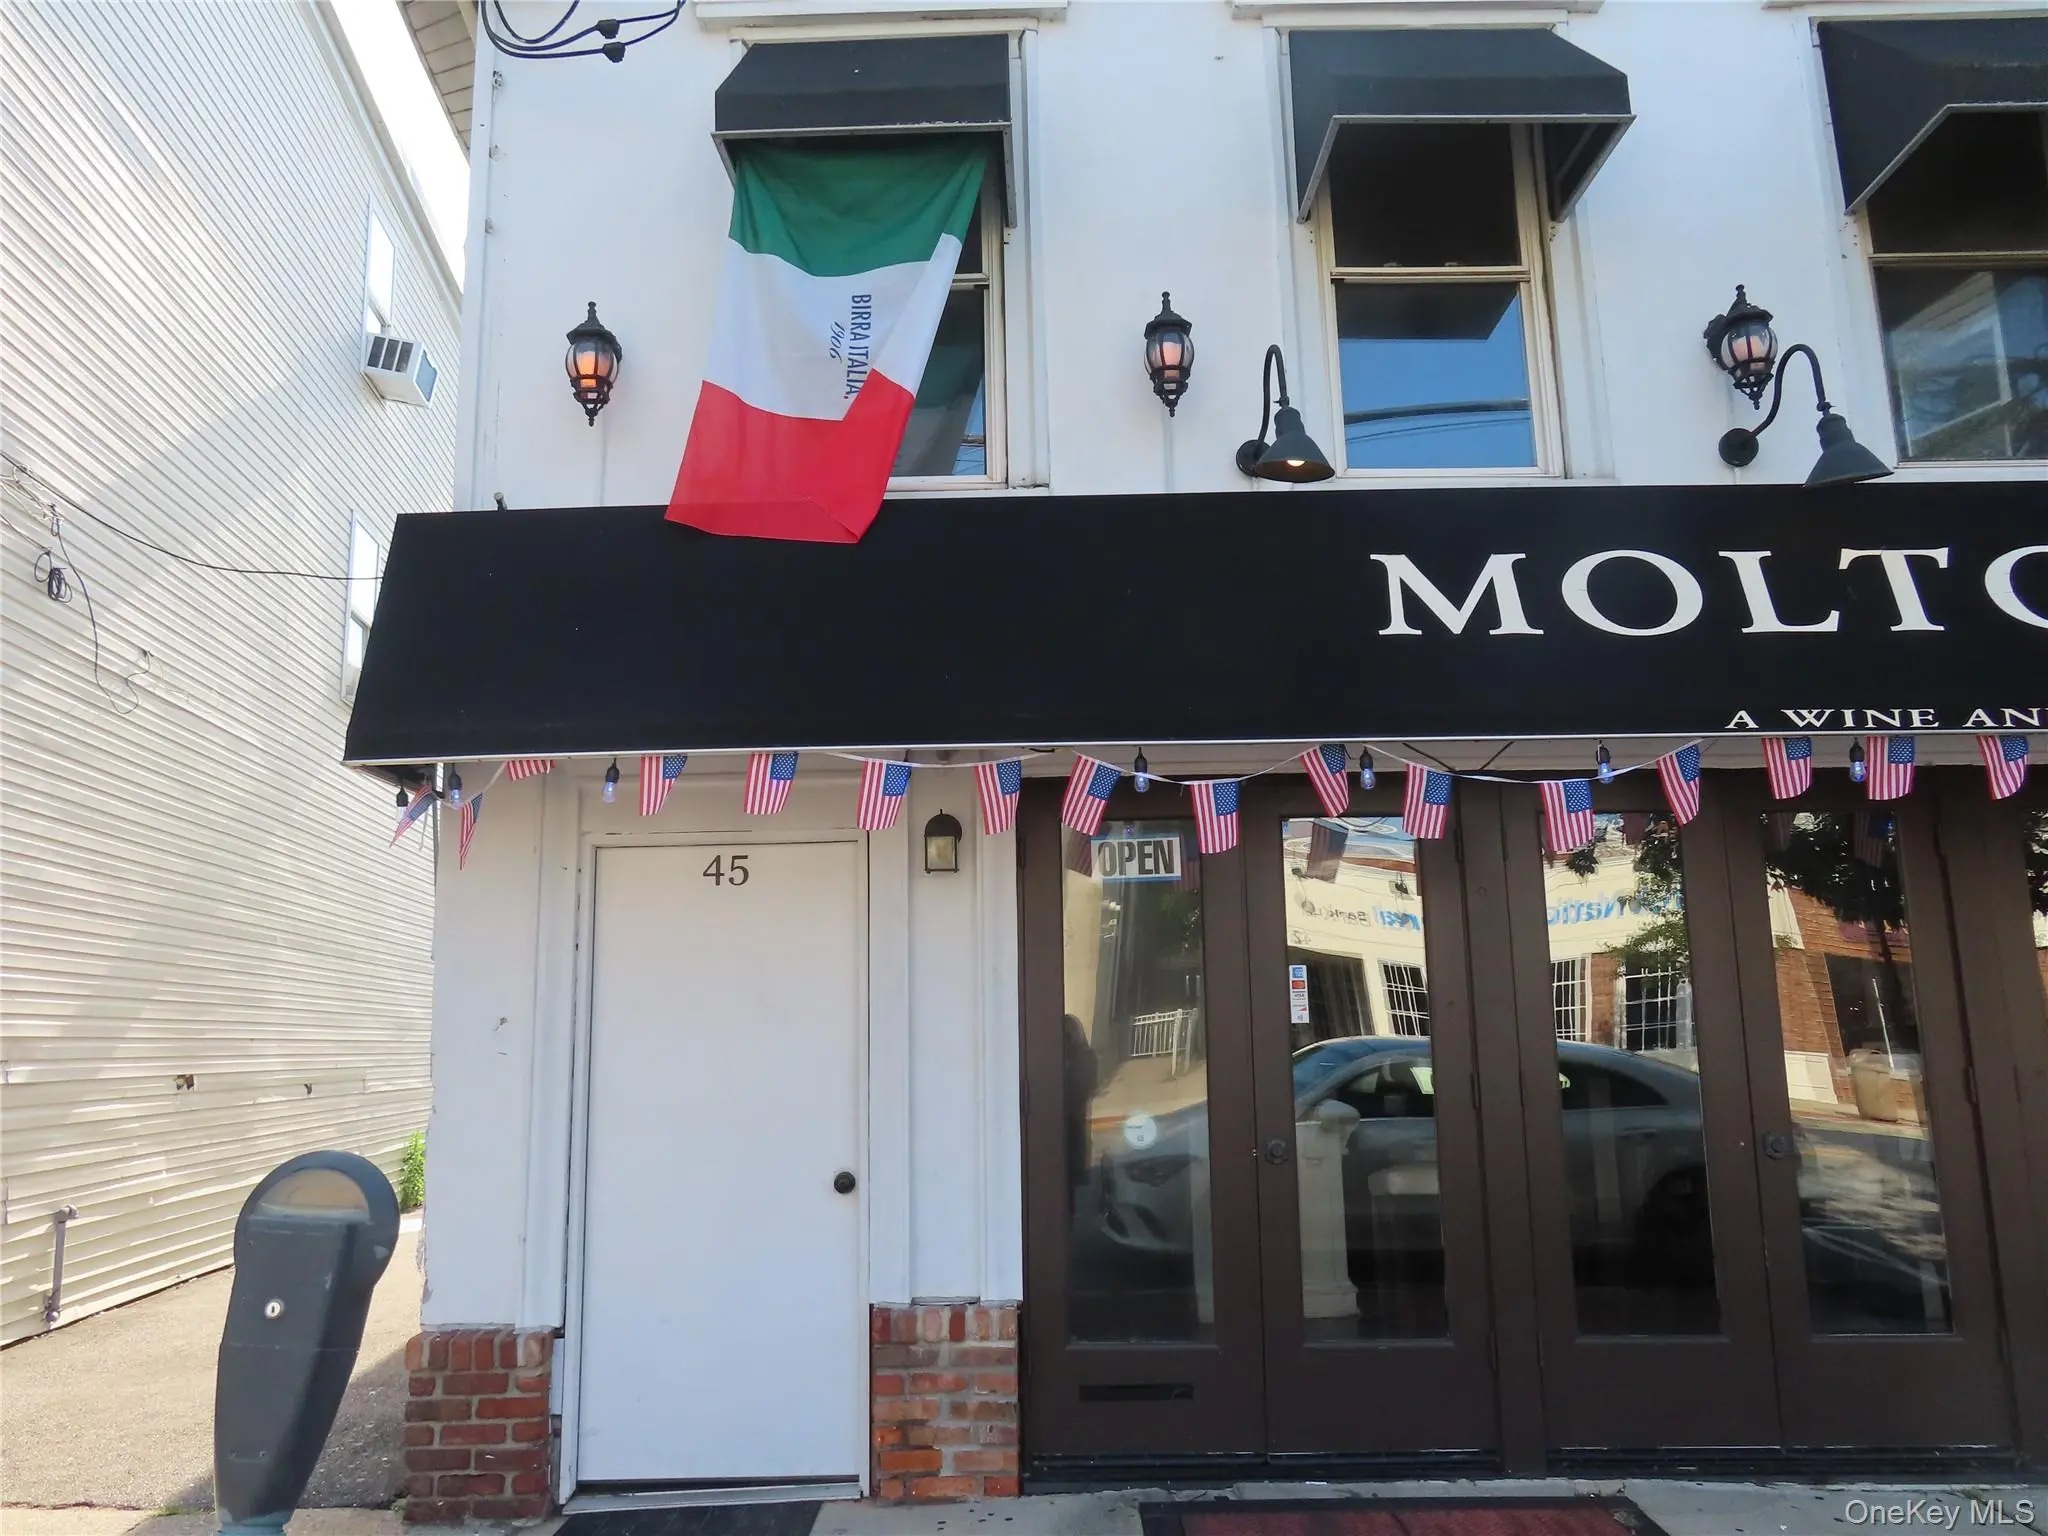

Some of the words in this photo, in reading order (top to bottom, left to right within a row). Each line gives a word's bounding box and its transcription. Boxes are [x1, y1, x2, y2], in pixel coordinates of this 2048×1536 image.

[850, 294, 872, 341] BIRRA
[1724, 709, 1760, 729] A
[1780, 708, 1940, 728] WINE
[1961, 707, 2048, 728] AN
[702, 854, 749, 886] 45
[1098, 839, 1175, 877] OPEN
